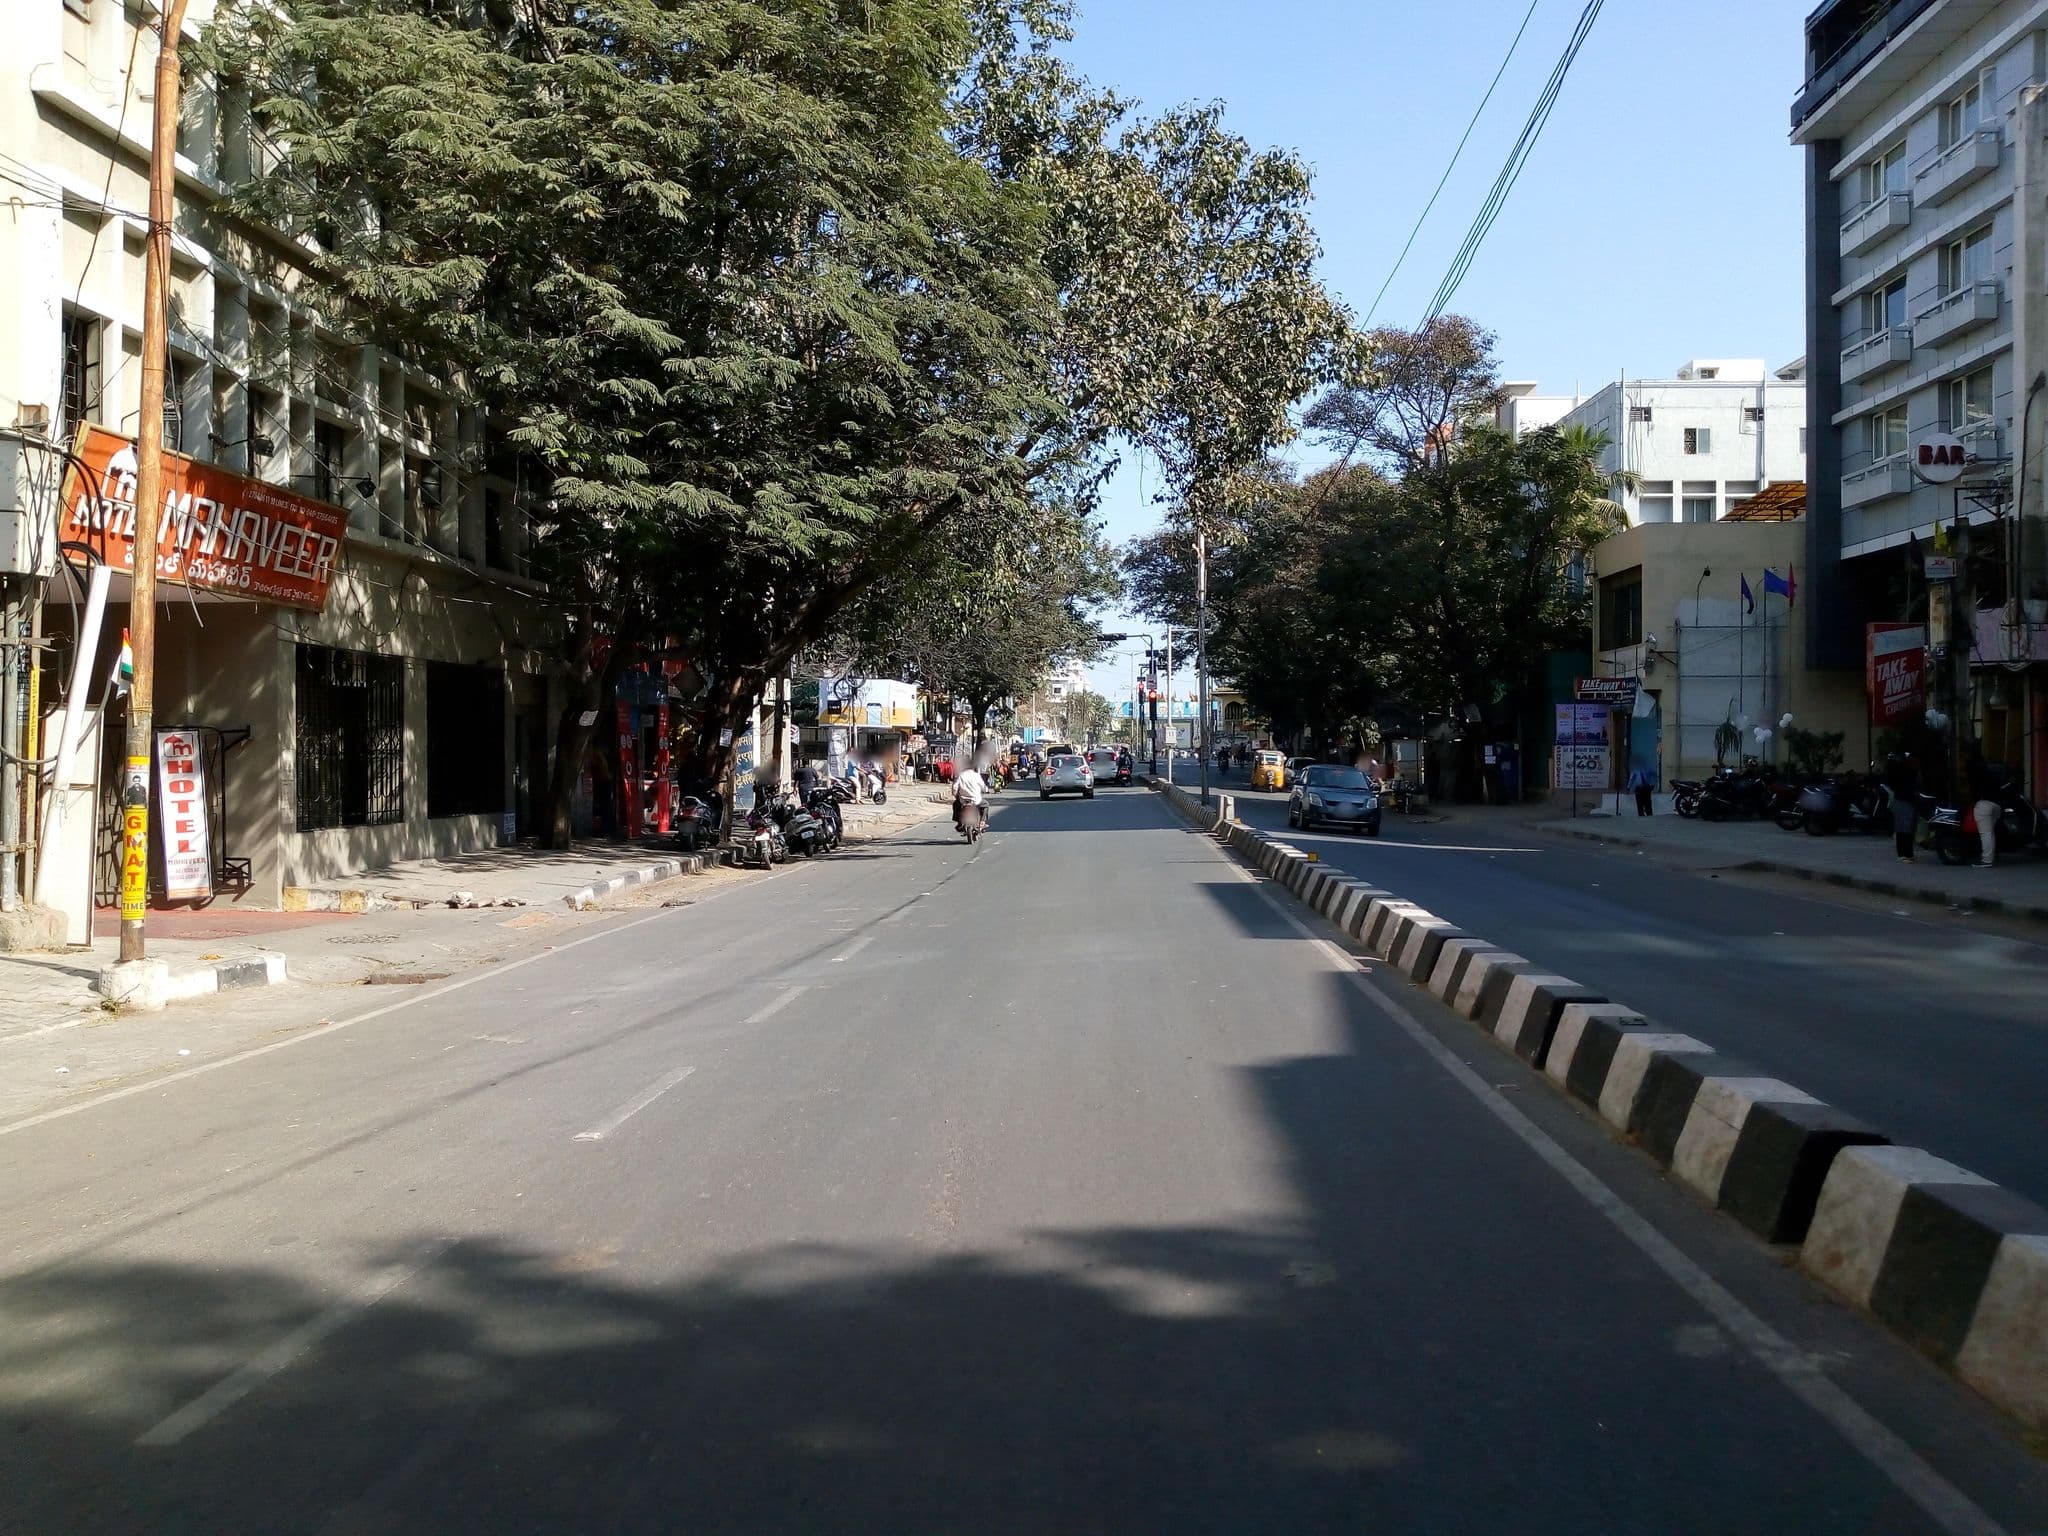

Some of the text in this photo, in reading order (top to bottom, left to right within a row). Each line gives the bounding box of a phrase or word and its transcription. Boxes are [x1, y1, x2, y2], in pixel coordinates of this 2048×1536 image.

[1919, 444, 1965, 465] BAR
[71, 489, 338, 583] HOTE MAHAVEER
[1876, 657, 1908, 682] TAKE
[1582, 680, 1600, 688] TAKE
[1600, 682, 1620, 690] AWAY
[1884, 670, 1920, 697] AWAY
[167, 760, 196, 854] HOTEL
[125, 815, 144, 886] GMAT
[122, 902, 144, 911] TIME
